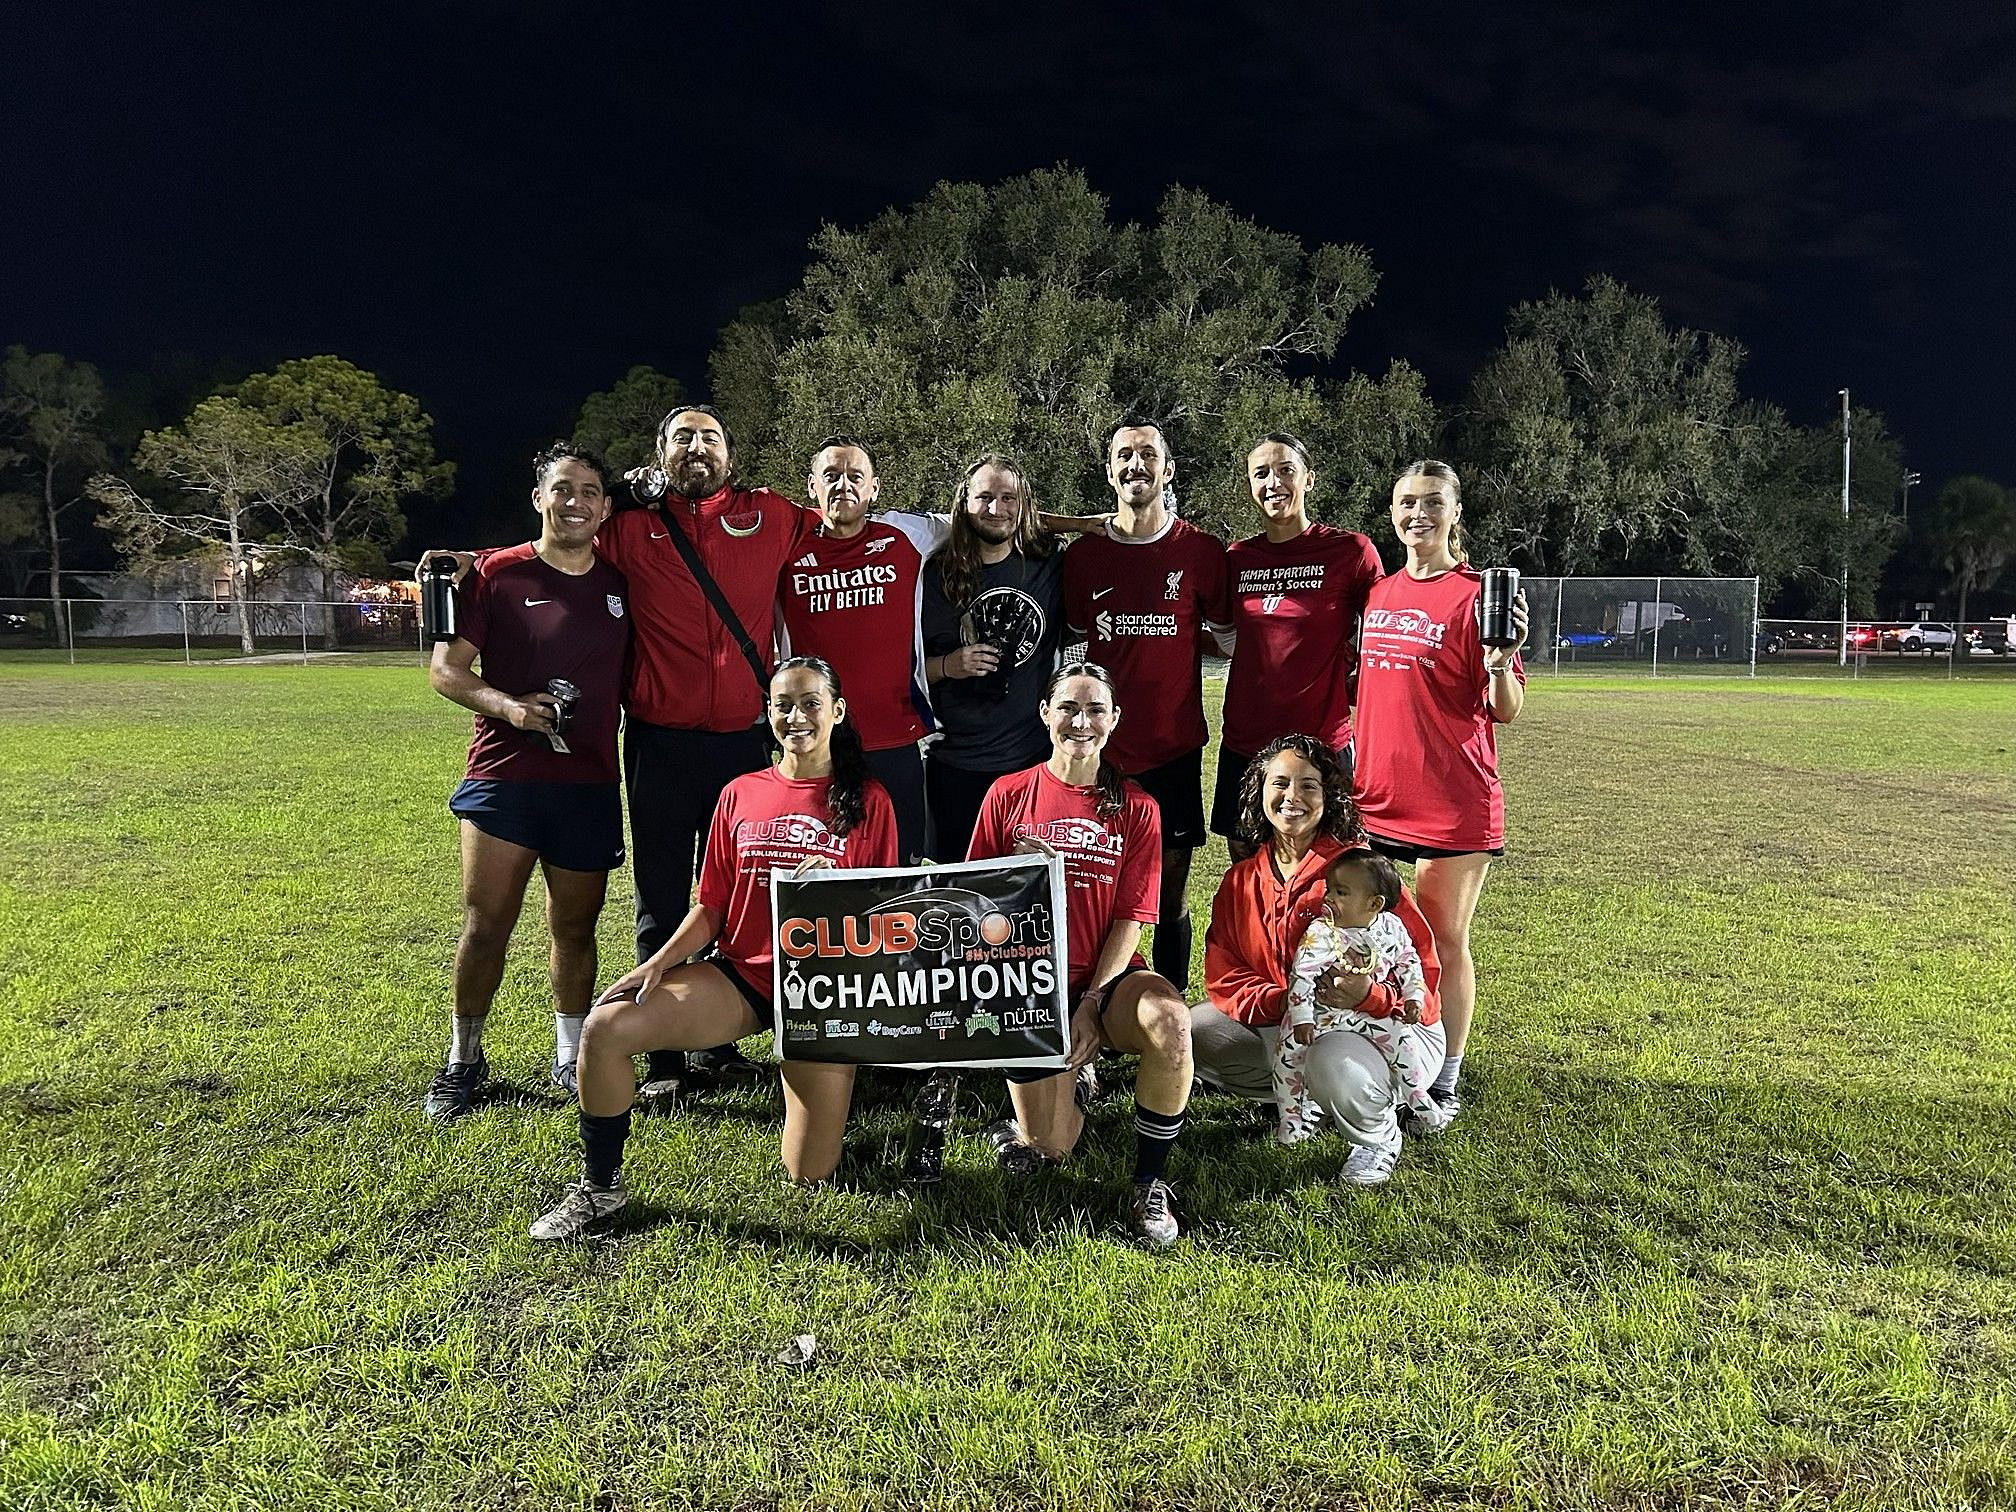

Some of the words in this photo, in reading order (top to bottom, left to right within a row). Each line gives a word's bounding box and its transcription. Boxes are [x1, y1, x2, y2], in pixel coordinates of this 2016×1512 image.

[792, 564, 897, 595] Emirates
[1240, 568, 1270, 581] TAMPA
[1273, 565, 1324, 579] SPARTANS
[1238, 581, 1283, 592] Women's
[1286, 580, 1323, 590] Soccer
[810, 592, 831, 613] FLY
[836, 586, 884, 609] BETTER
[1164, 592, 1179, 600] LFC
[1115, 613, 1175, 625] standard
[1115, 624, 1178, 636] chartered
[737, 821, 847, 851] CLUBSport
[1012, 822, 1123, 851] CLUBSport
[1078, 853, 1093, 861] PLAY
[1094, 855, 1115, 866] SPORTS
[779, 904, 1052, 959] CLUBSport
[965, 943, 1052, 963] #MyClubSport
[807, 959, 1055, 1010] CHAMPIONS
[925, 1016, 960, 1027] ULTRA
[881, 1025, 923, 1038] BayCare
